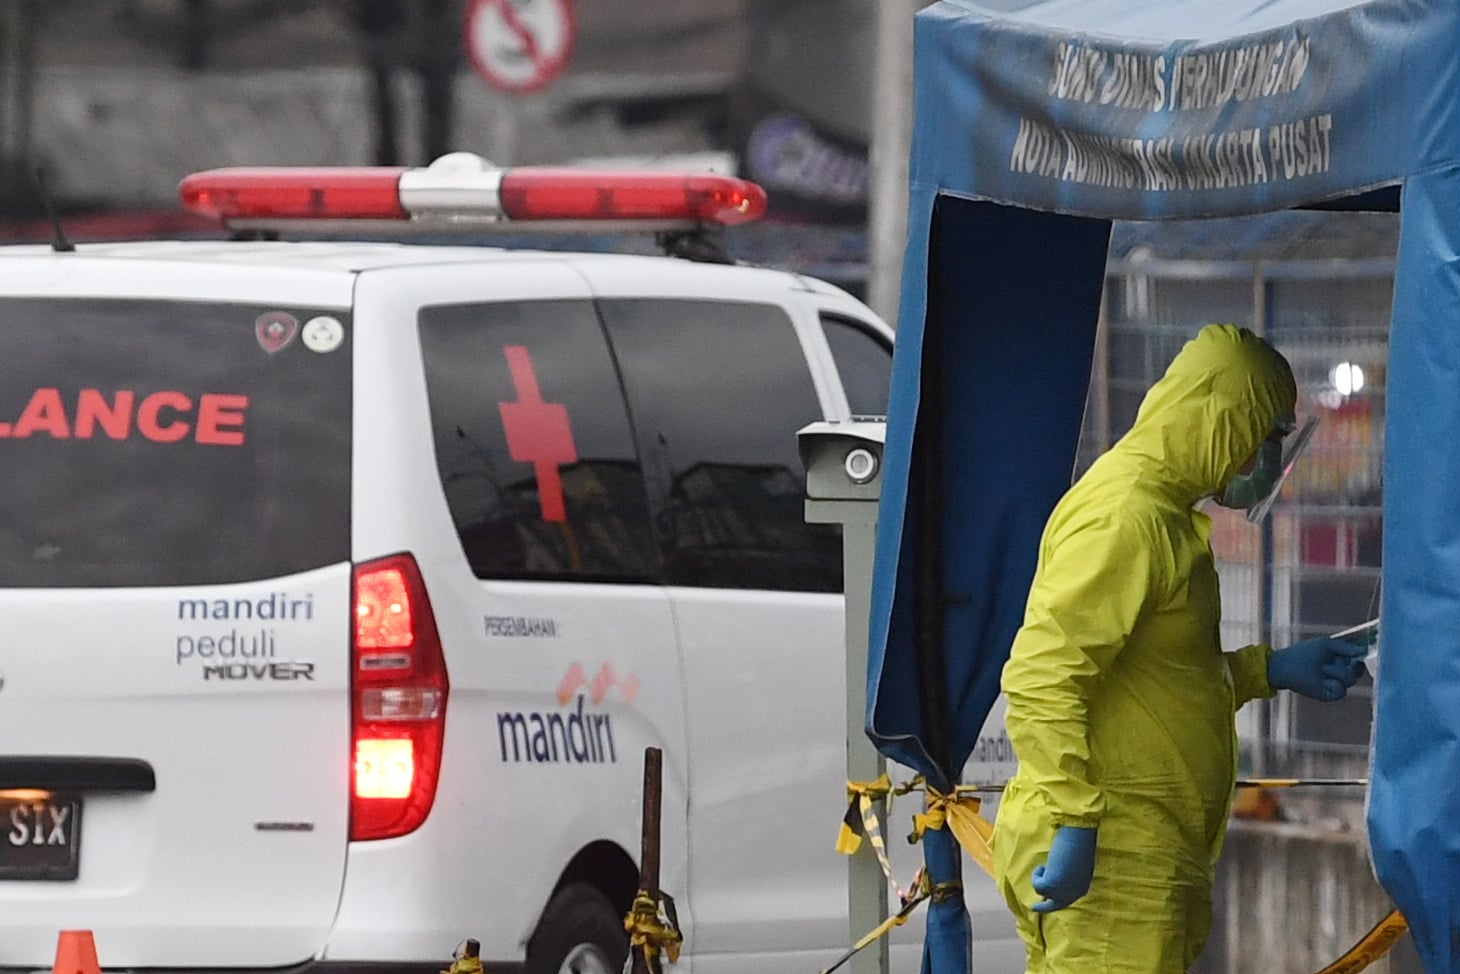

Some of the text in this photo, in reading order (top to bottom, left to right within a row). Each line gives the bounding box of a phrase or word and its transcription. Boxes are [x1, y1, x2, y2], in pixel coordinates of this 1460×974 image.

[1268, 114, 1332, 181] PUSAT
[0, 387, 248, 445] ANCE
[178, 592, 313, 620] mandiri
[177, 628, 275, 665] peduli
[203, 662, 315, 680] MOVER
[497, 693, 617, 763] mandiri
